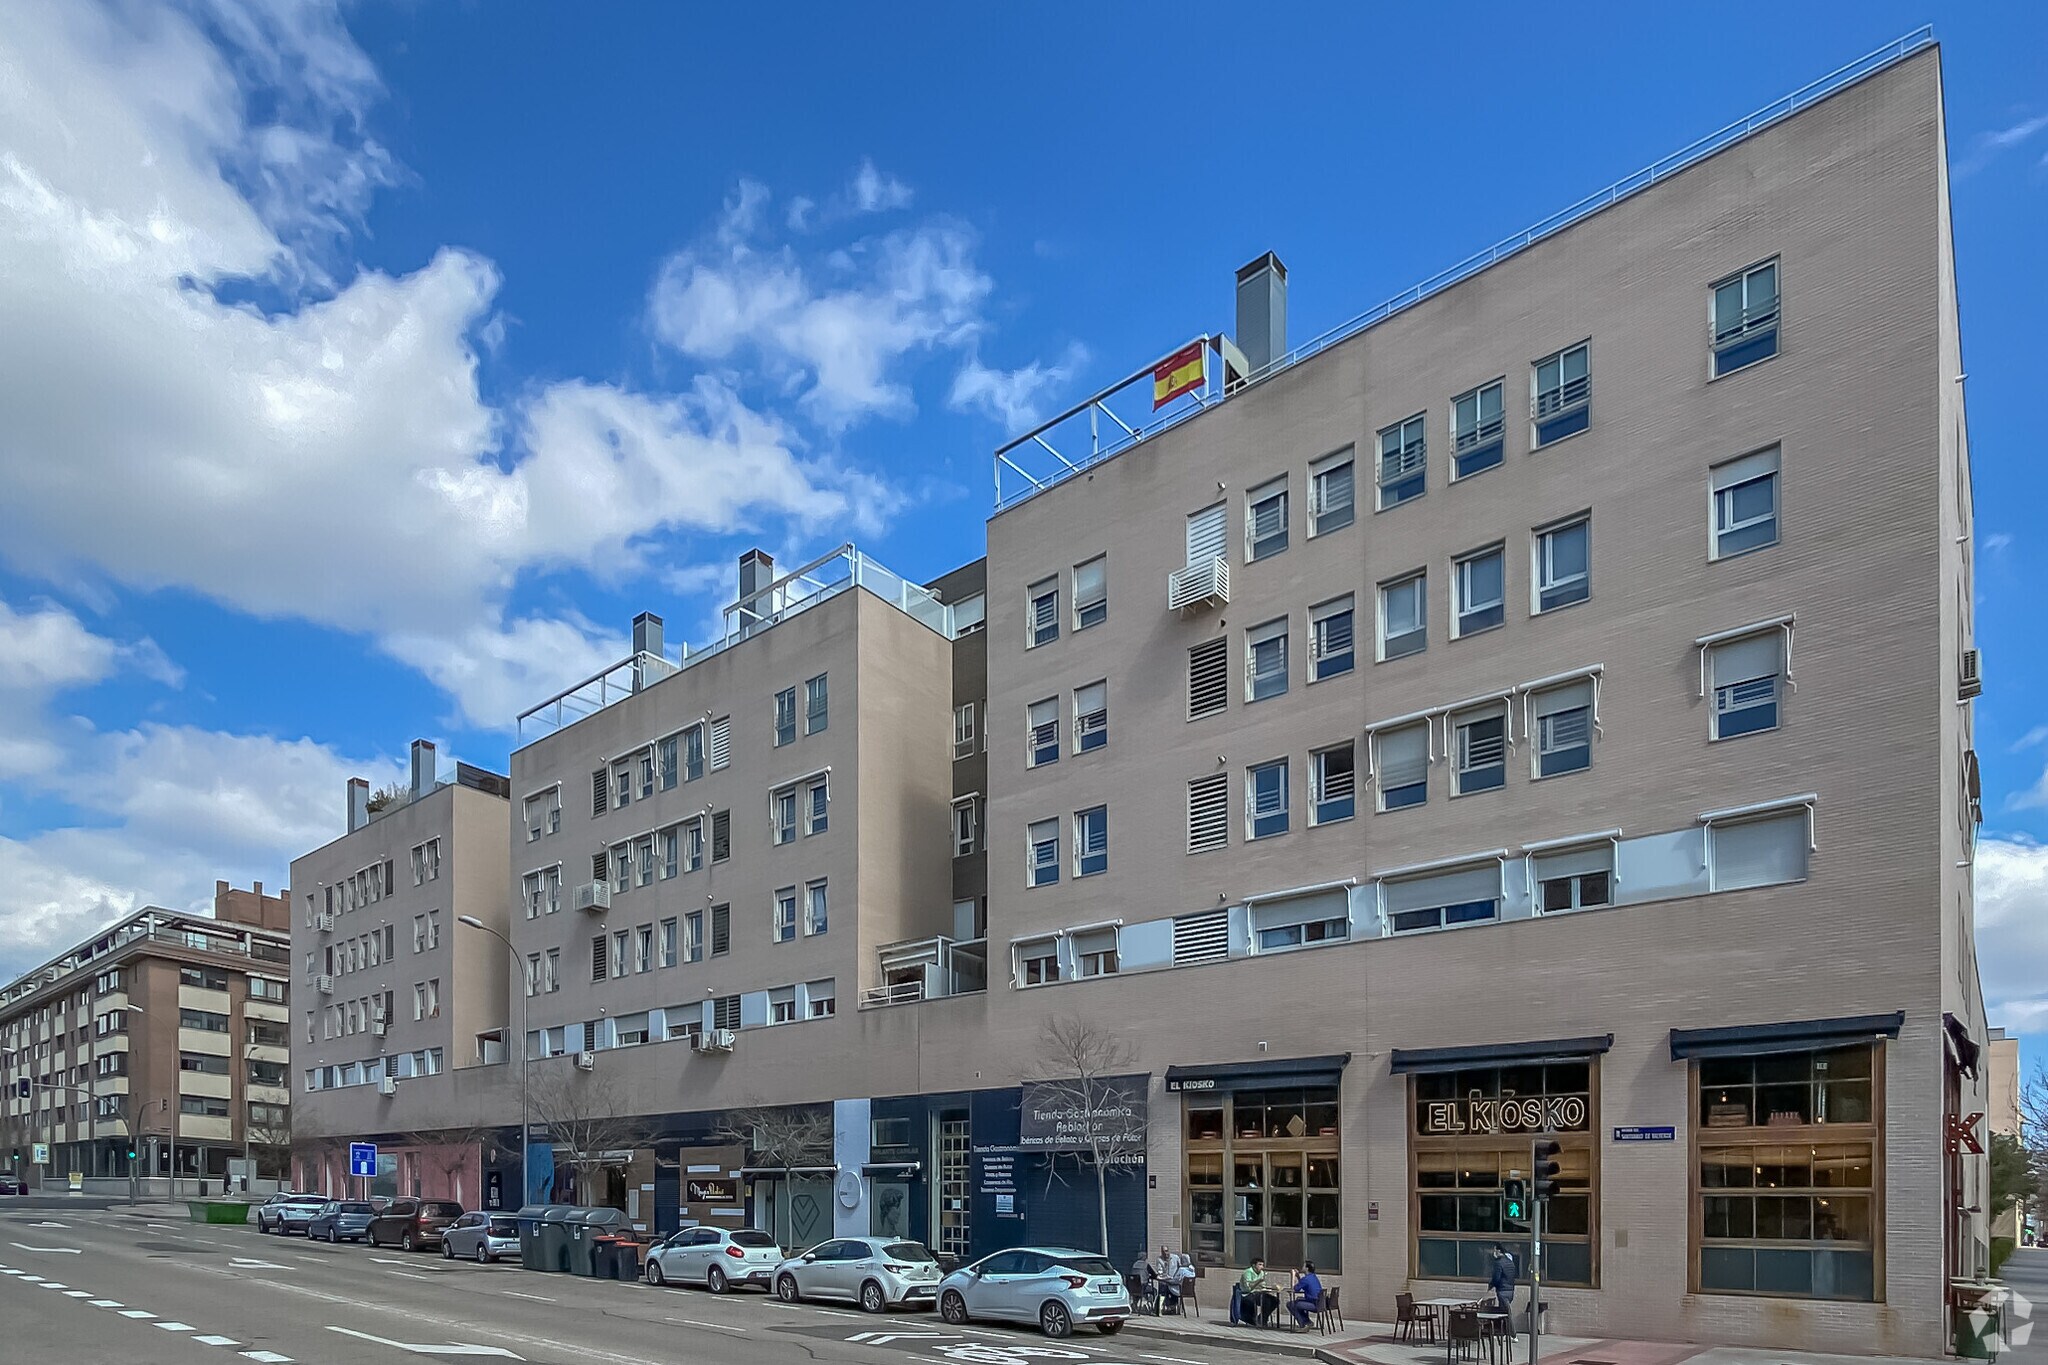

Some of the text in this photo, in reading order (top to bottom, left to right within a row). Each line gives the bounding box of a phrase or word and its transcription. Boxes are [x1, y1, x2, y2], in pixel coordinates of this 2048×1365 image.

[1170, 1080, 1215, 1090] EL KIOSKO
[1033, 1109, 1063, 1121] Tienda
[1428, 1097, 1585, 1131] EL KIOSKO
[1945, 1112, 1985, 1154] K
